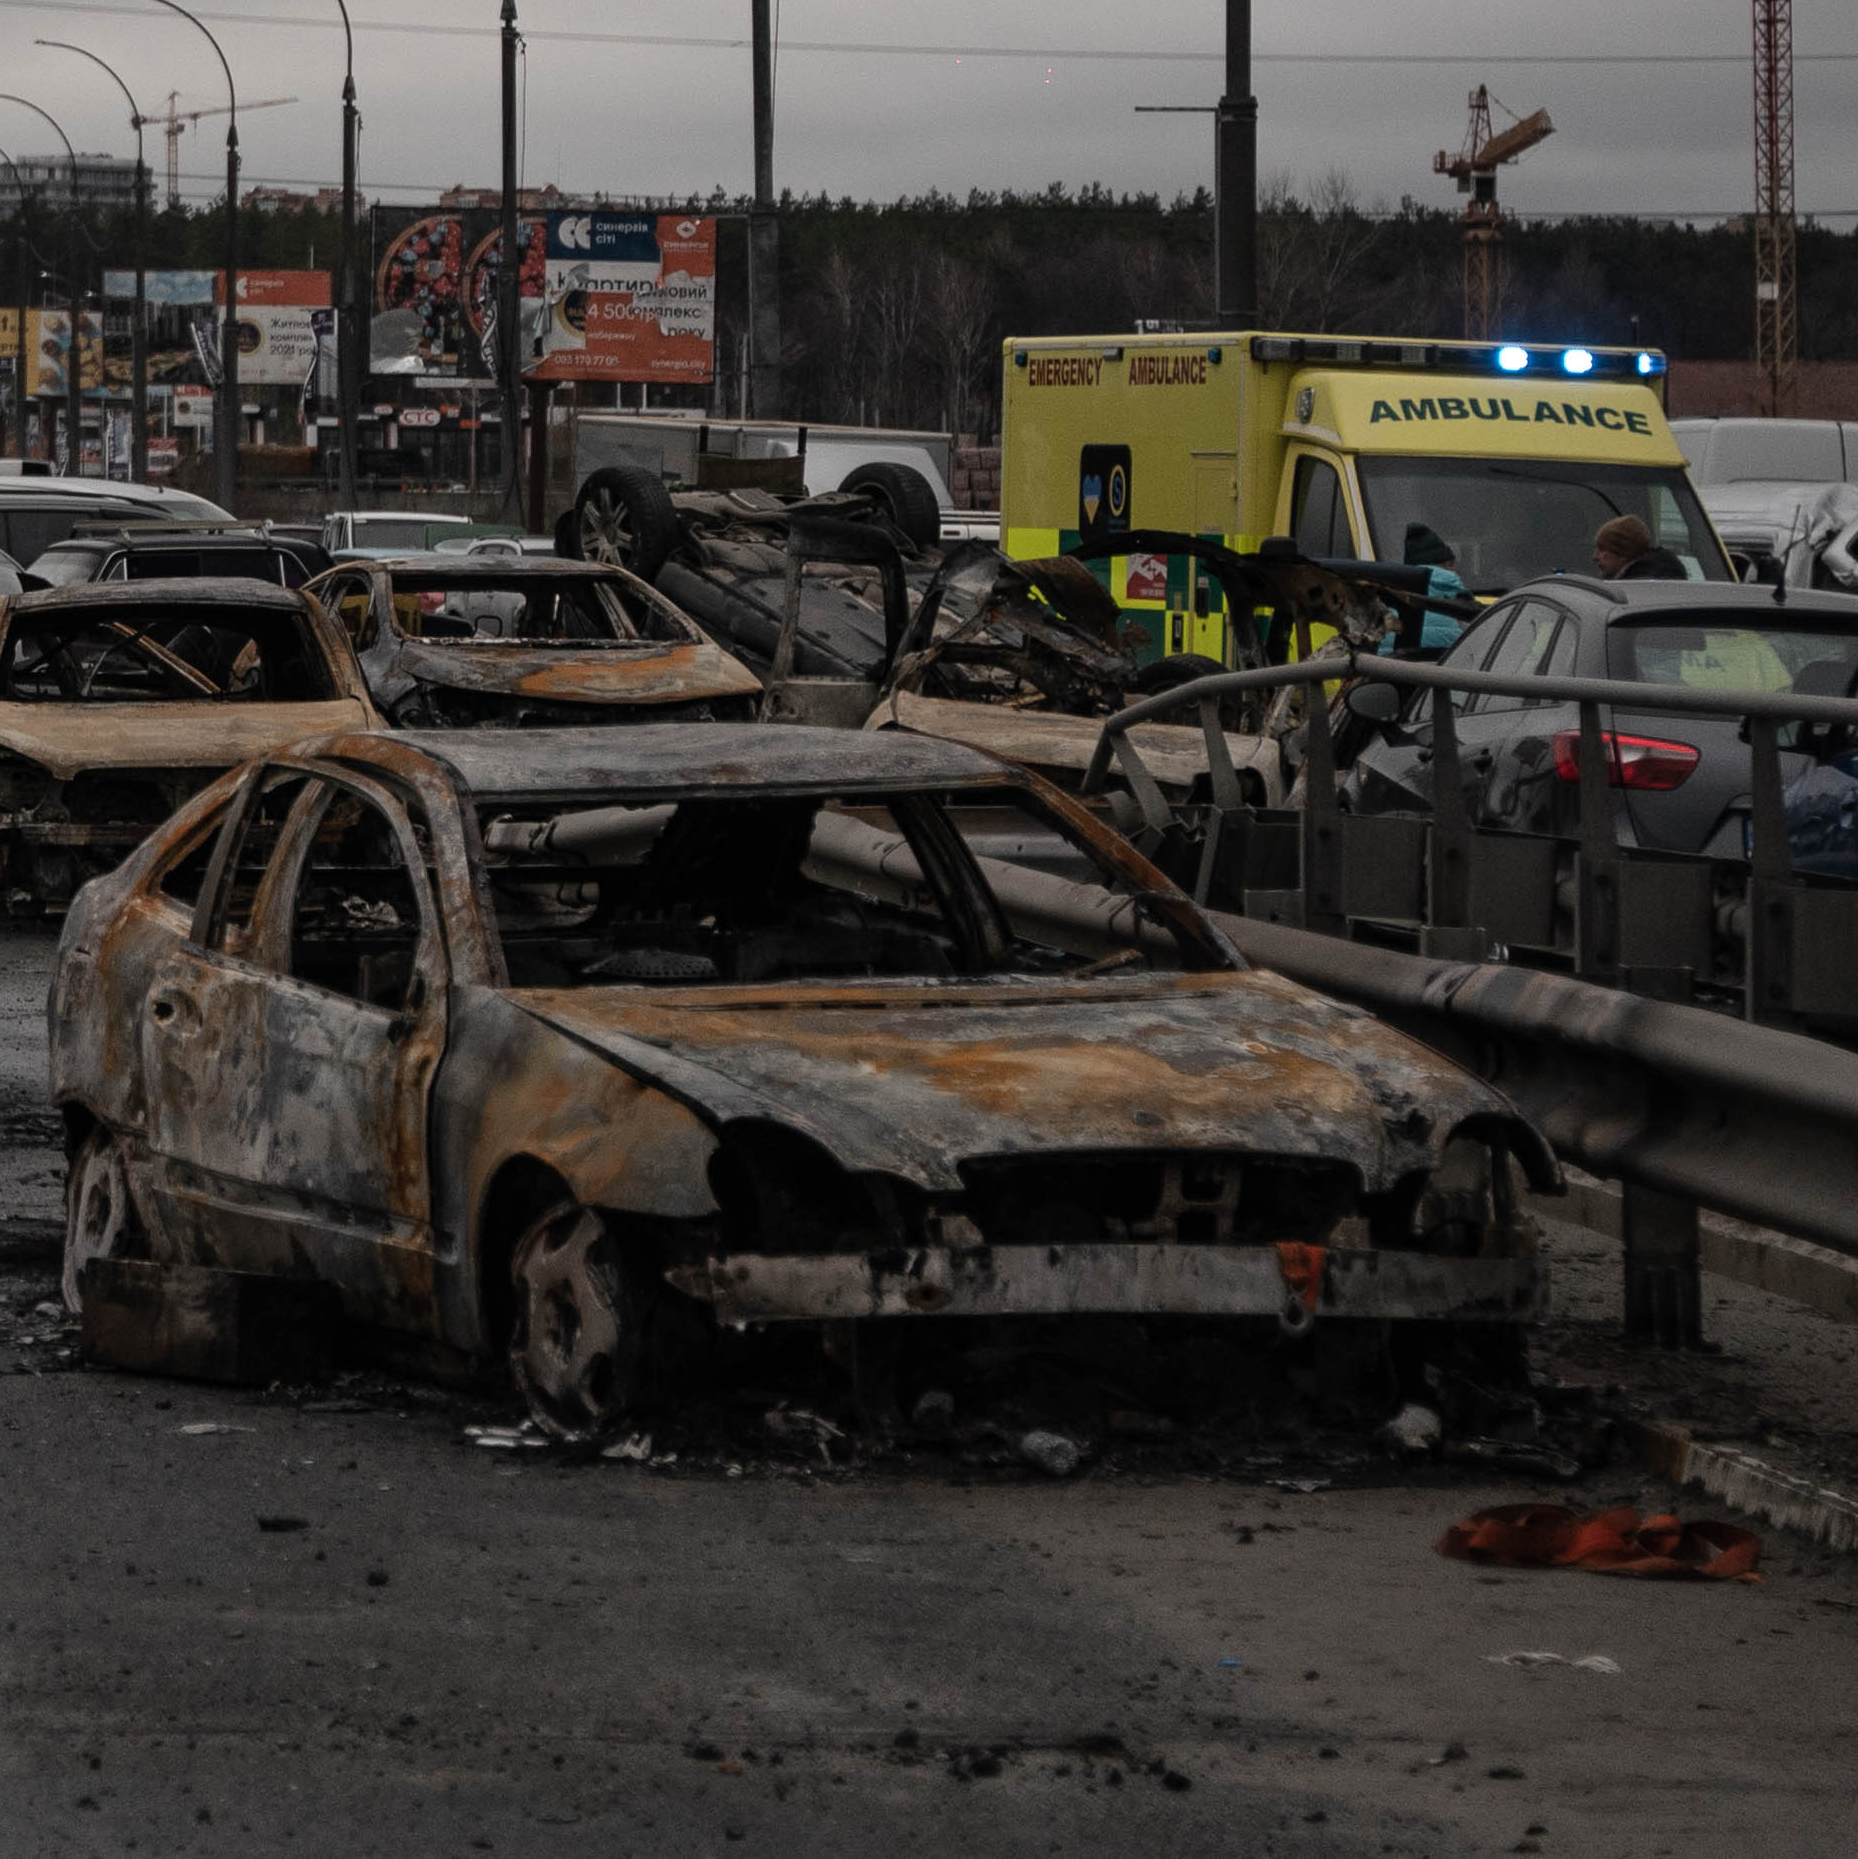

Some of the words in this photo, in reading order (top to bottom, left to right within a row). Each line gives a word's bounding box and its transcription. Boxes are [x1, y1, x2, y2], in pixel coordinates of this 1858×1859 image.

[1028, 357, 1103, 386] EMERGENCY
[1128, 355, 1207, 385] AMBULANCE
[1370, 397, 1653, 436] AMBULANCE
